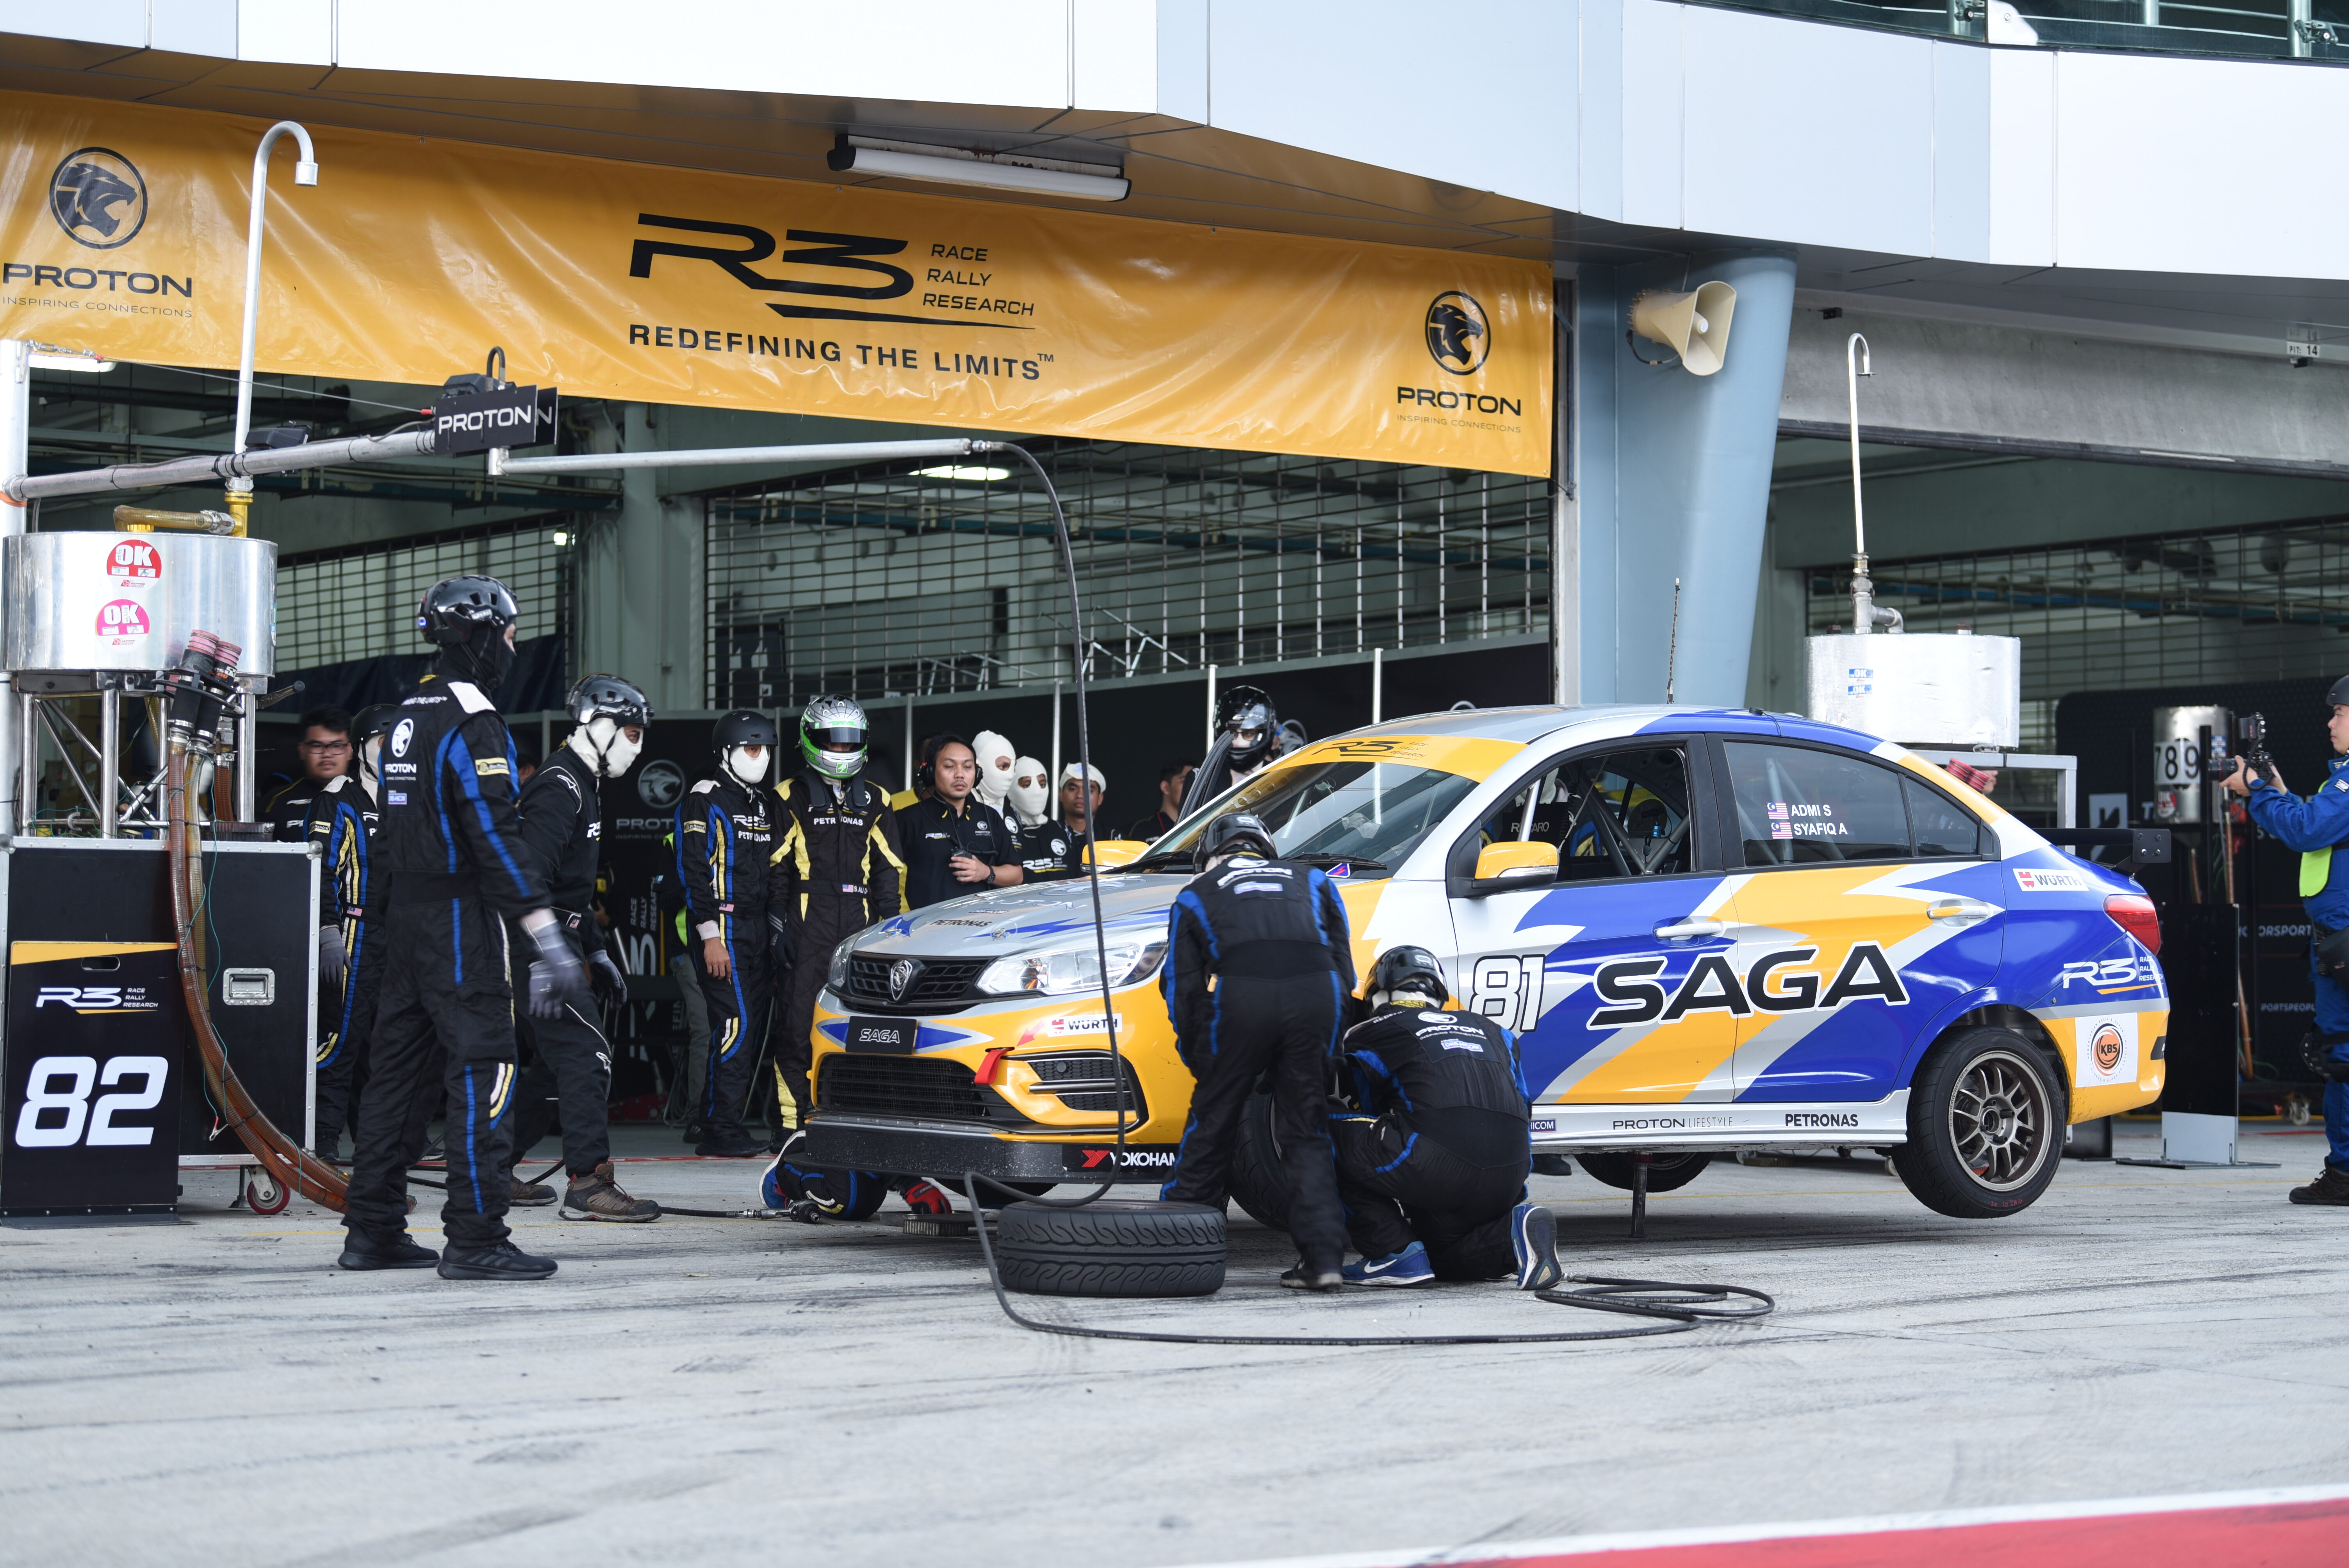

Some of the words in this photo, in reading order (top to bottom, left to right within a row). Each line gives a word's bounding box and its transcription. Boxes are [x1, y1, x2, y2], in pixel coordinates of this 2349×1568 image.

[629, 213, 914, 300] R3
[931, 244, 988, 262] RACE
[3, 263, 192, 298] PROTON
[927, 268, 992, 287] RALLY
[2, 296, 79, 309] INSPIRING
[86, 302, 192, 318] CONNECTIONS
[922, 293, 1034, 316] RESEARCH
[629, 324, 840, 362] REDEFINING
[857, 345, 918, 369] THE
[2307, 344, 2317, 355] 14
[1397, 387, 1521, 416] PROTON
[439, 405, 531, 435] PROTON
[1397, 414, 1447, 425] INSPIRING
[1451, 419, 1521, 433] CONNECTIONS
[115, 544, 153, 566] OK
[104, 605, 140, 625] OK
[1854, 669, 1867, 677] OK
[1853, 685, 1866, 694] OK
[1311, 741, 1404, 755] R3
[1791, 804, 1821, 816] ADMI
[1823, 804, 1832, 816] S
[616, 818, 675, 830] PROT
[1511, 821, 1549, 832] RARO
[1793, 823, 1837, 836] SYAFIQ
[1839, 823, 1848, 835] A
[2063, 958, 2137, 989] R3
[1469, 954, 1546, 1032] 81
[1586, 940, 1910, 1030] SAGA
[36, 987, 121, 1007] R3
[859, 1028, 900, 1043] SAGA
[1415, 1025, 1485, 1037] PROTON
[2101, 1043, 2117, 1056] KBS
[15, 1056, 168, 1147] 82
[1530, 1121, 1554, 1131] HICOM
[1613, 1119, 1685, 1130] PROTON
[1689, 1117, 1733, 1128] LIFESTYLE
[1785, 1114, 1858, 1127] PETRONAS
